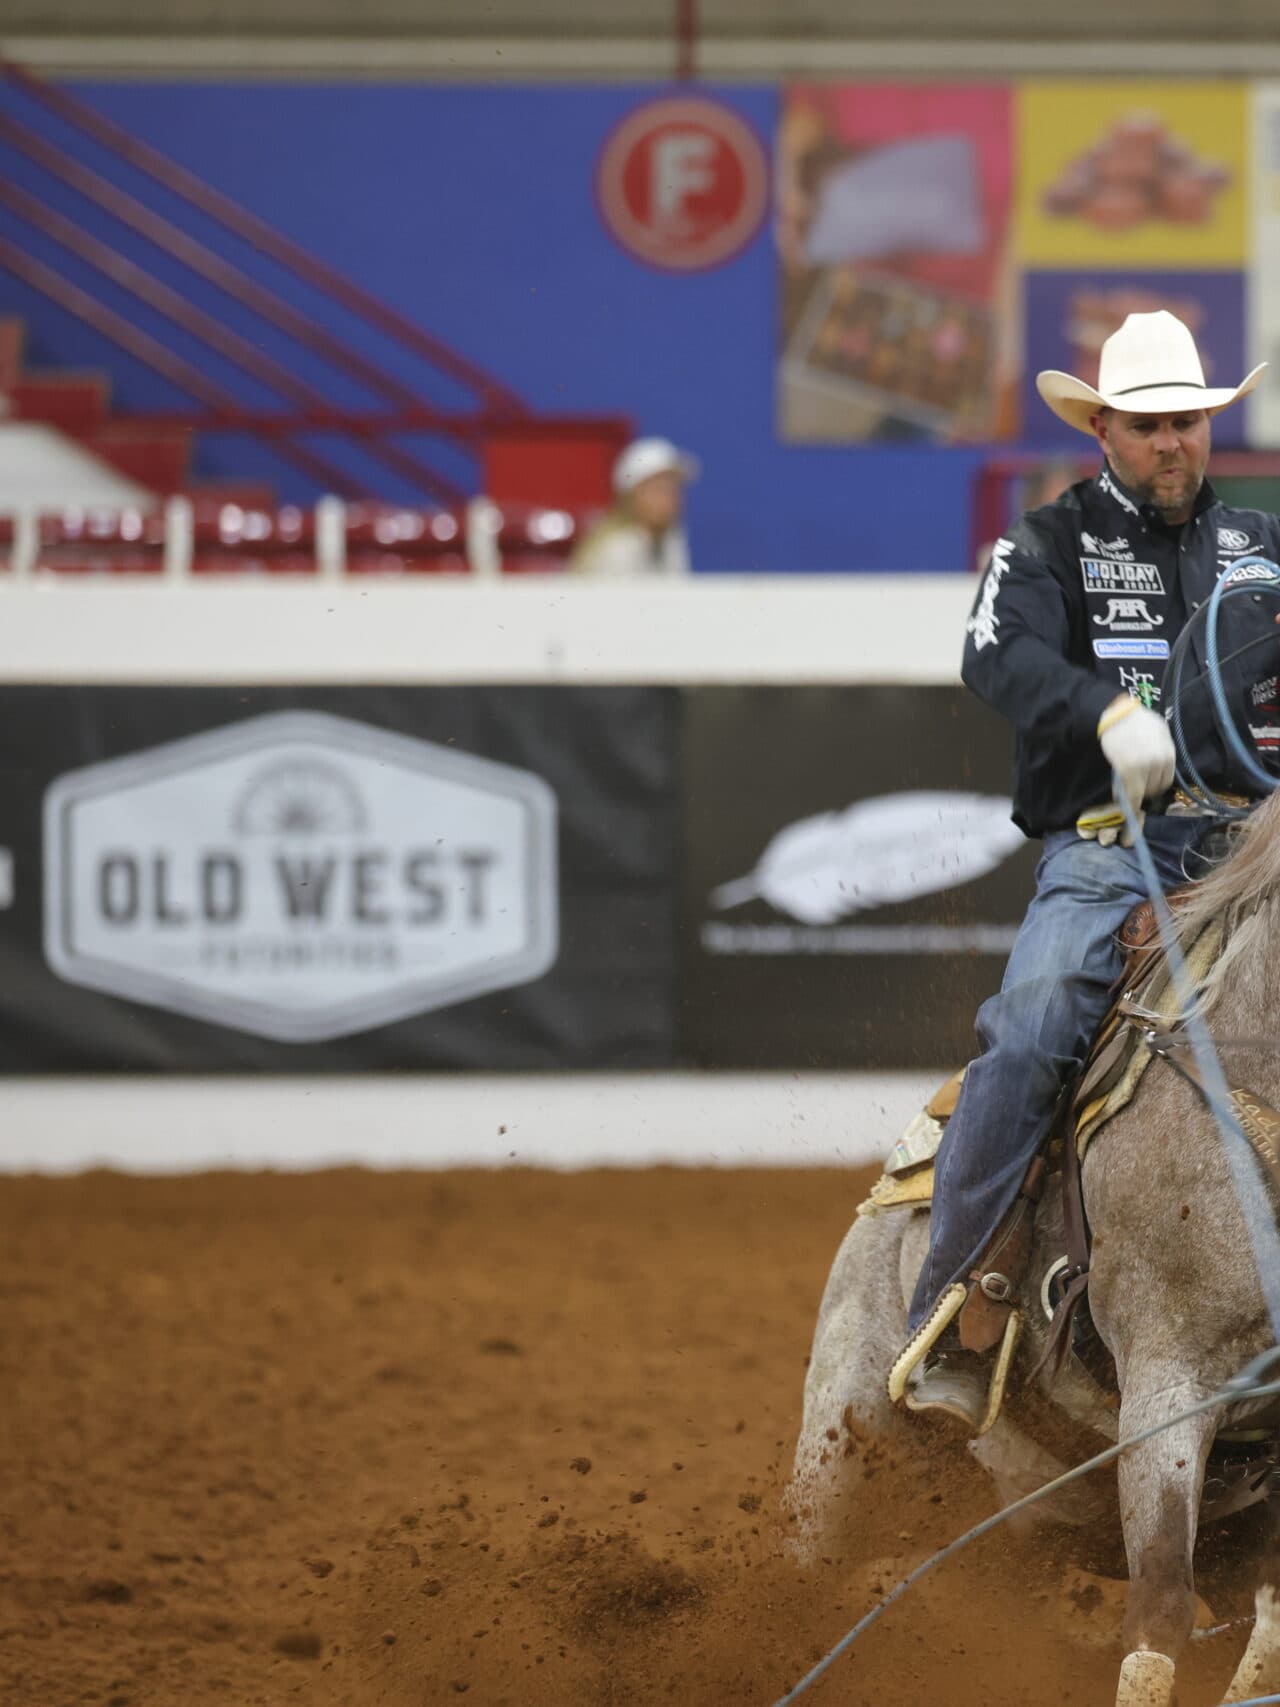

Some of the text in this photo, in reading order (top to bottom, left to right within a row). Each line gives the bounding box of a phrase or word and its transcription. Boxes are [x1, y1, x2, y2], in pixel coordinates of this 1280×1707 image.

[1086, 561, 1156, 582] HOLIDAY
[1087, 579, 1117, 590] AUTO
[98, 851, 244, 929] OLD
[272, 851, 497, 929] WEST
